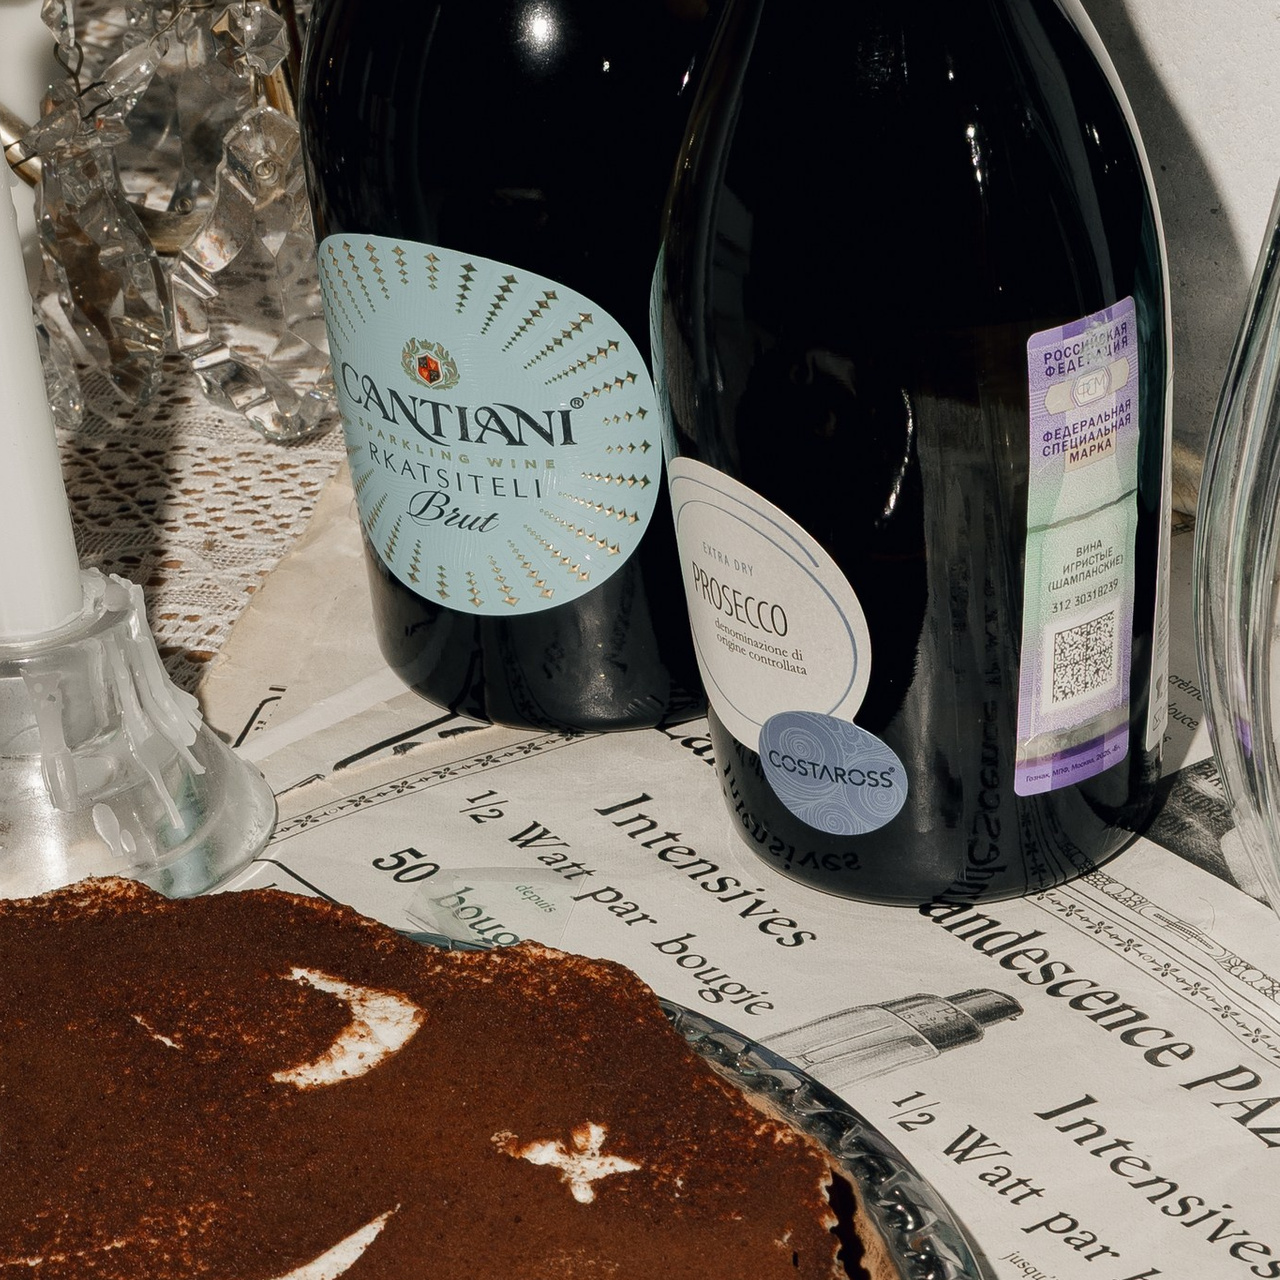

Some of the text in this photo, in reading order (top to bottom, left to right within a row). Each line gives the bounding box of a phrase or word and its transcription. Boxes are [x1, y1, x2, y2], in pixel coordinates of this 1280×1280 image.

[340, 361, 579, 448] CANTIANI
[1042, 398, 1132, 443] ФЕДЕРАЛЬНАЯ
[358, 416, 556, 470] SPARKLING WINE
[1041, 412, 1132, 458] СПЕЦИАЛЬНАЯ
[1069, 437, 1113, 465] МАРКА
[368, 440, 543, 500] RKATSITELI
[405, 489, 500, 534] Brut
[702, 541, 754, 578] EXTRA DRY
[1062, 546, 1114, 576] ИГРИСТЫЕ
[1076, 539, 1103, 558] ВИНА
[1047, 554, 1124, 593] (ШАМПАНСКИЕ)
[692, 560, 788, 638] PROSECCO
[1051, 598, 1072, 614] 312
[714, 617, 804, 662] denominazione di
[716, 632, 808, 677] origine controllata
[768, 750, 894, 789] COSTAROSS
[372, 847, 441, 884] 50
[593, 792, 819, 949] Intensives
[507, 820, 597, 880] Watt
[570, 885, 658, 927] par
[650, 932, 775, 1017] bougie
[942, 1124, 1046, 1206] Watt
[1020, 1210, 1121, 1262] par
[1033, 1093, 1280, 1280] Intensives
